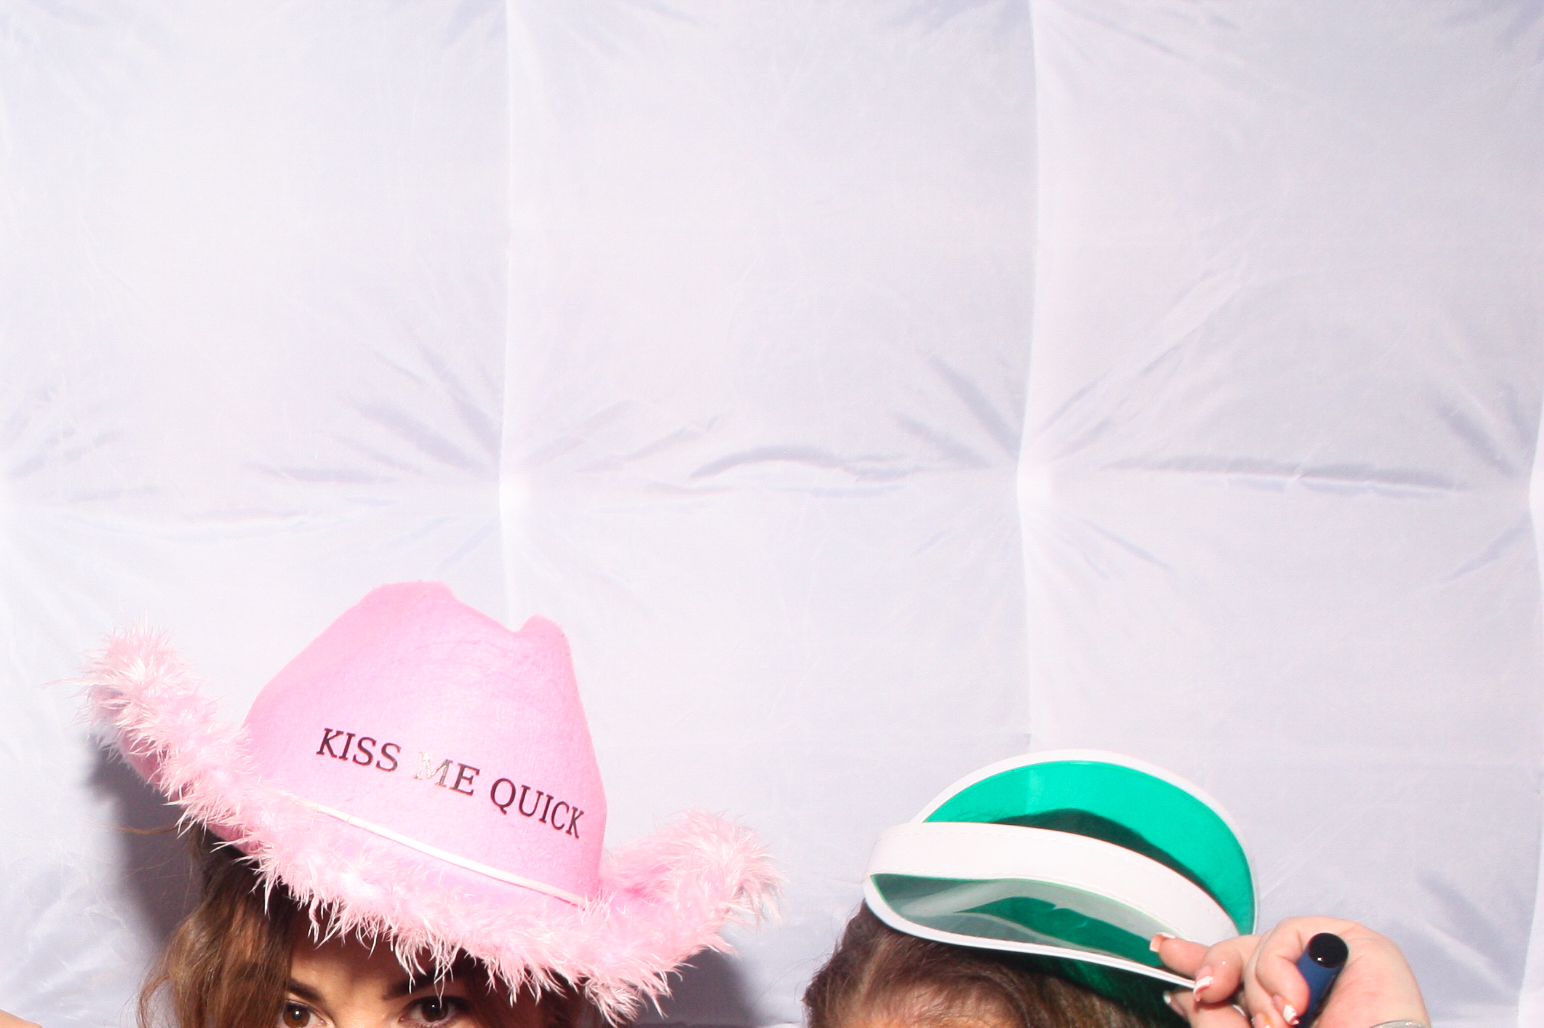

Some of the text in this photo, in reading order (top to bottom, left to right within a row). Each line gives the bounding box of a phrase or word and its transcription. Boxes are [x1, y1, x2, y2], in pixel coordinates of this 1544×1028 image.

[316, 727, 585, 839] KISS ME QUICK
